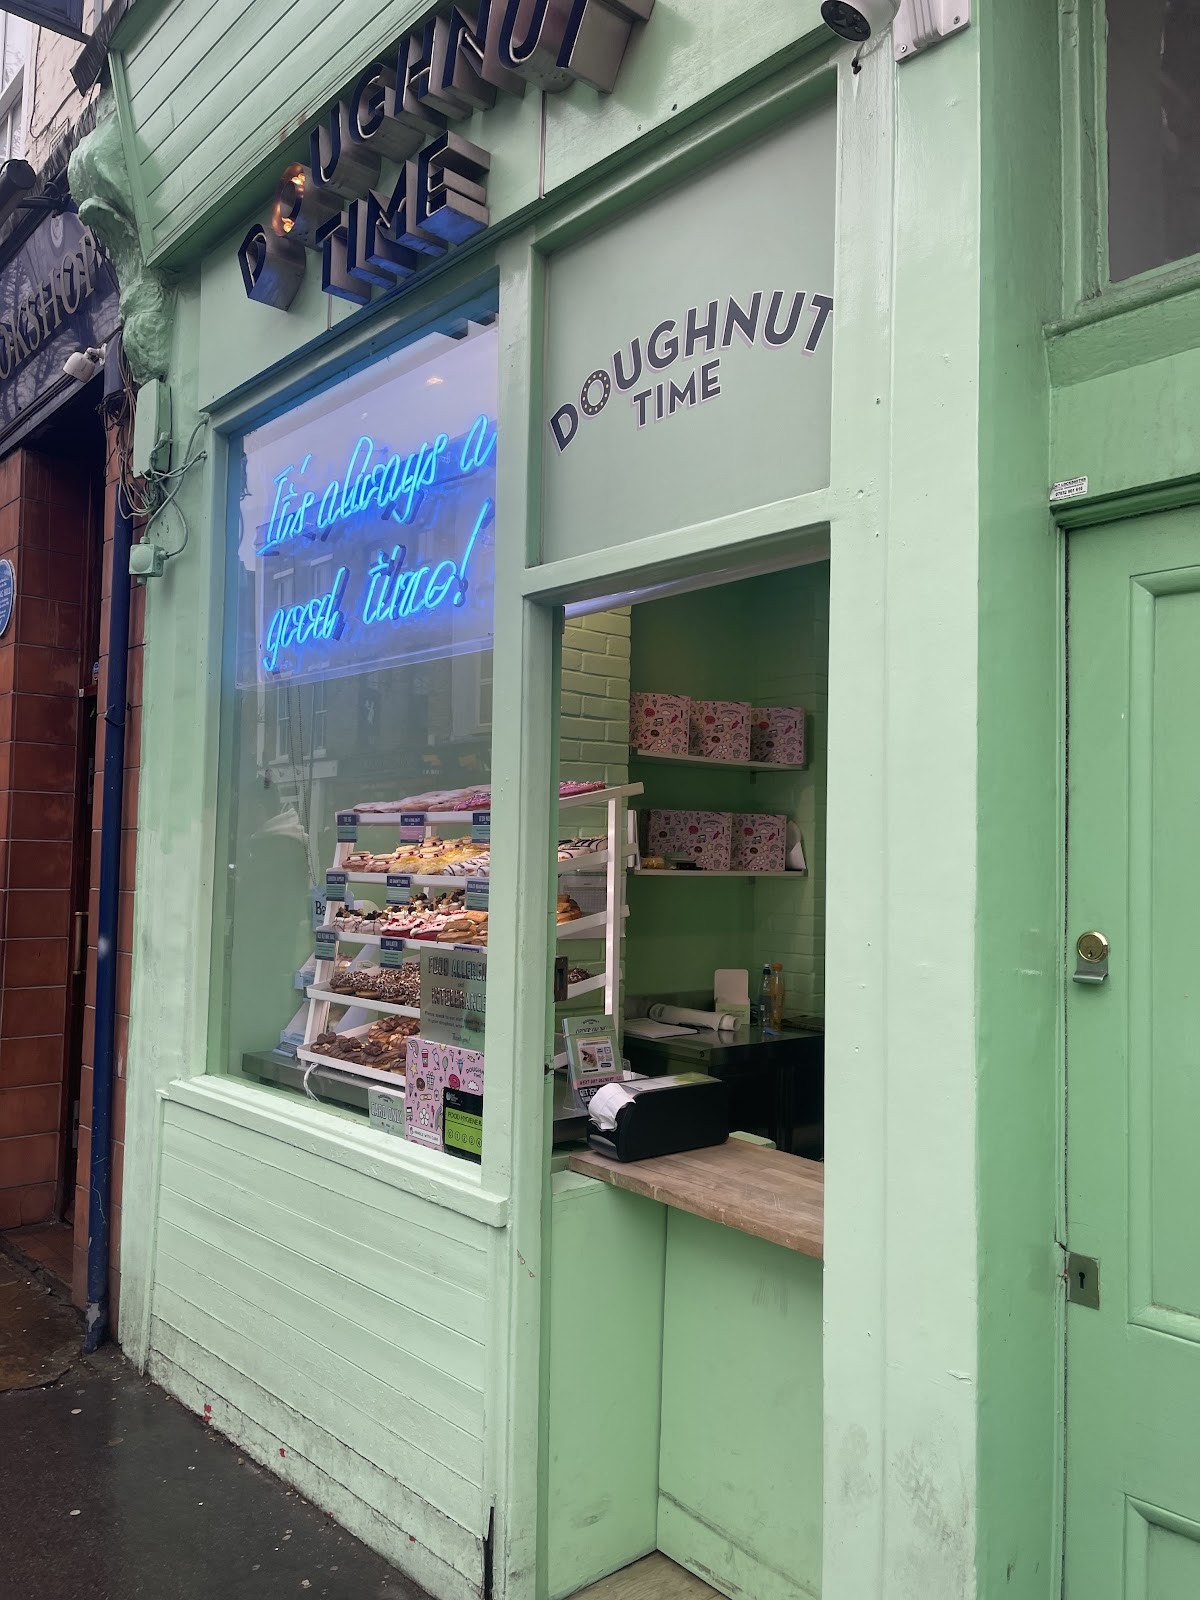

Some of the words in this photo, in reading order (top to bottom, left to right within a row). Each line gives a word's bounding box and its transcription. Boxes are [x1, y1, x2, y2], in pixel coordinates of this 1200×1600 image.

[315, 130, 488, 304] TIME
[549, 289, 834, 453] DOUGHNUT
[632, 357, 721, 428] TIME
[316, 435, 450, 524] always
[263, 565, 350, 671] good
[362, 497, 492, 625] time!
[429, 956, 449, 976] FOOD
